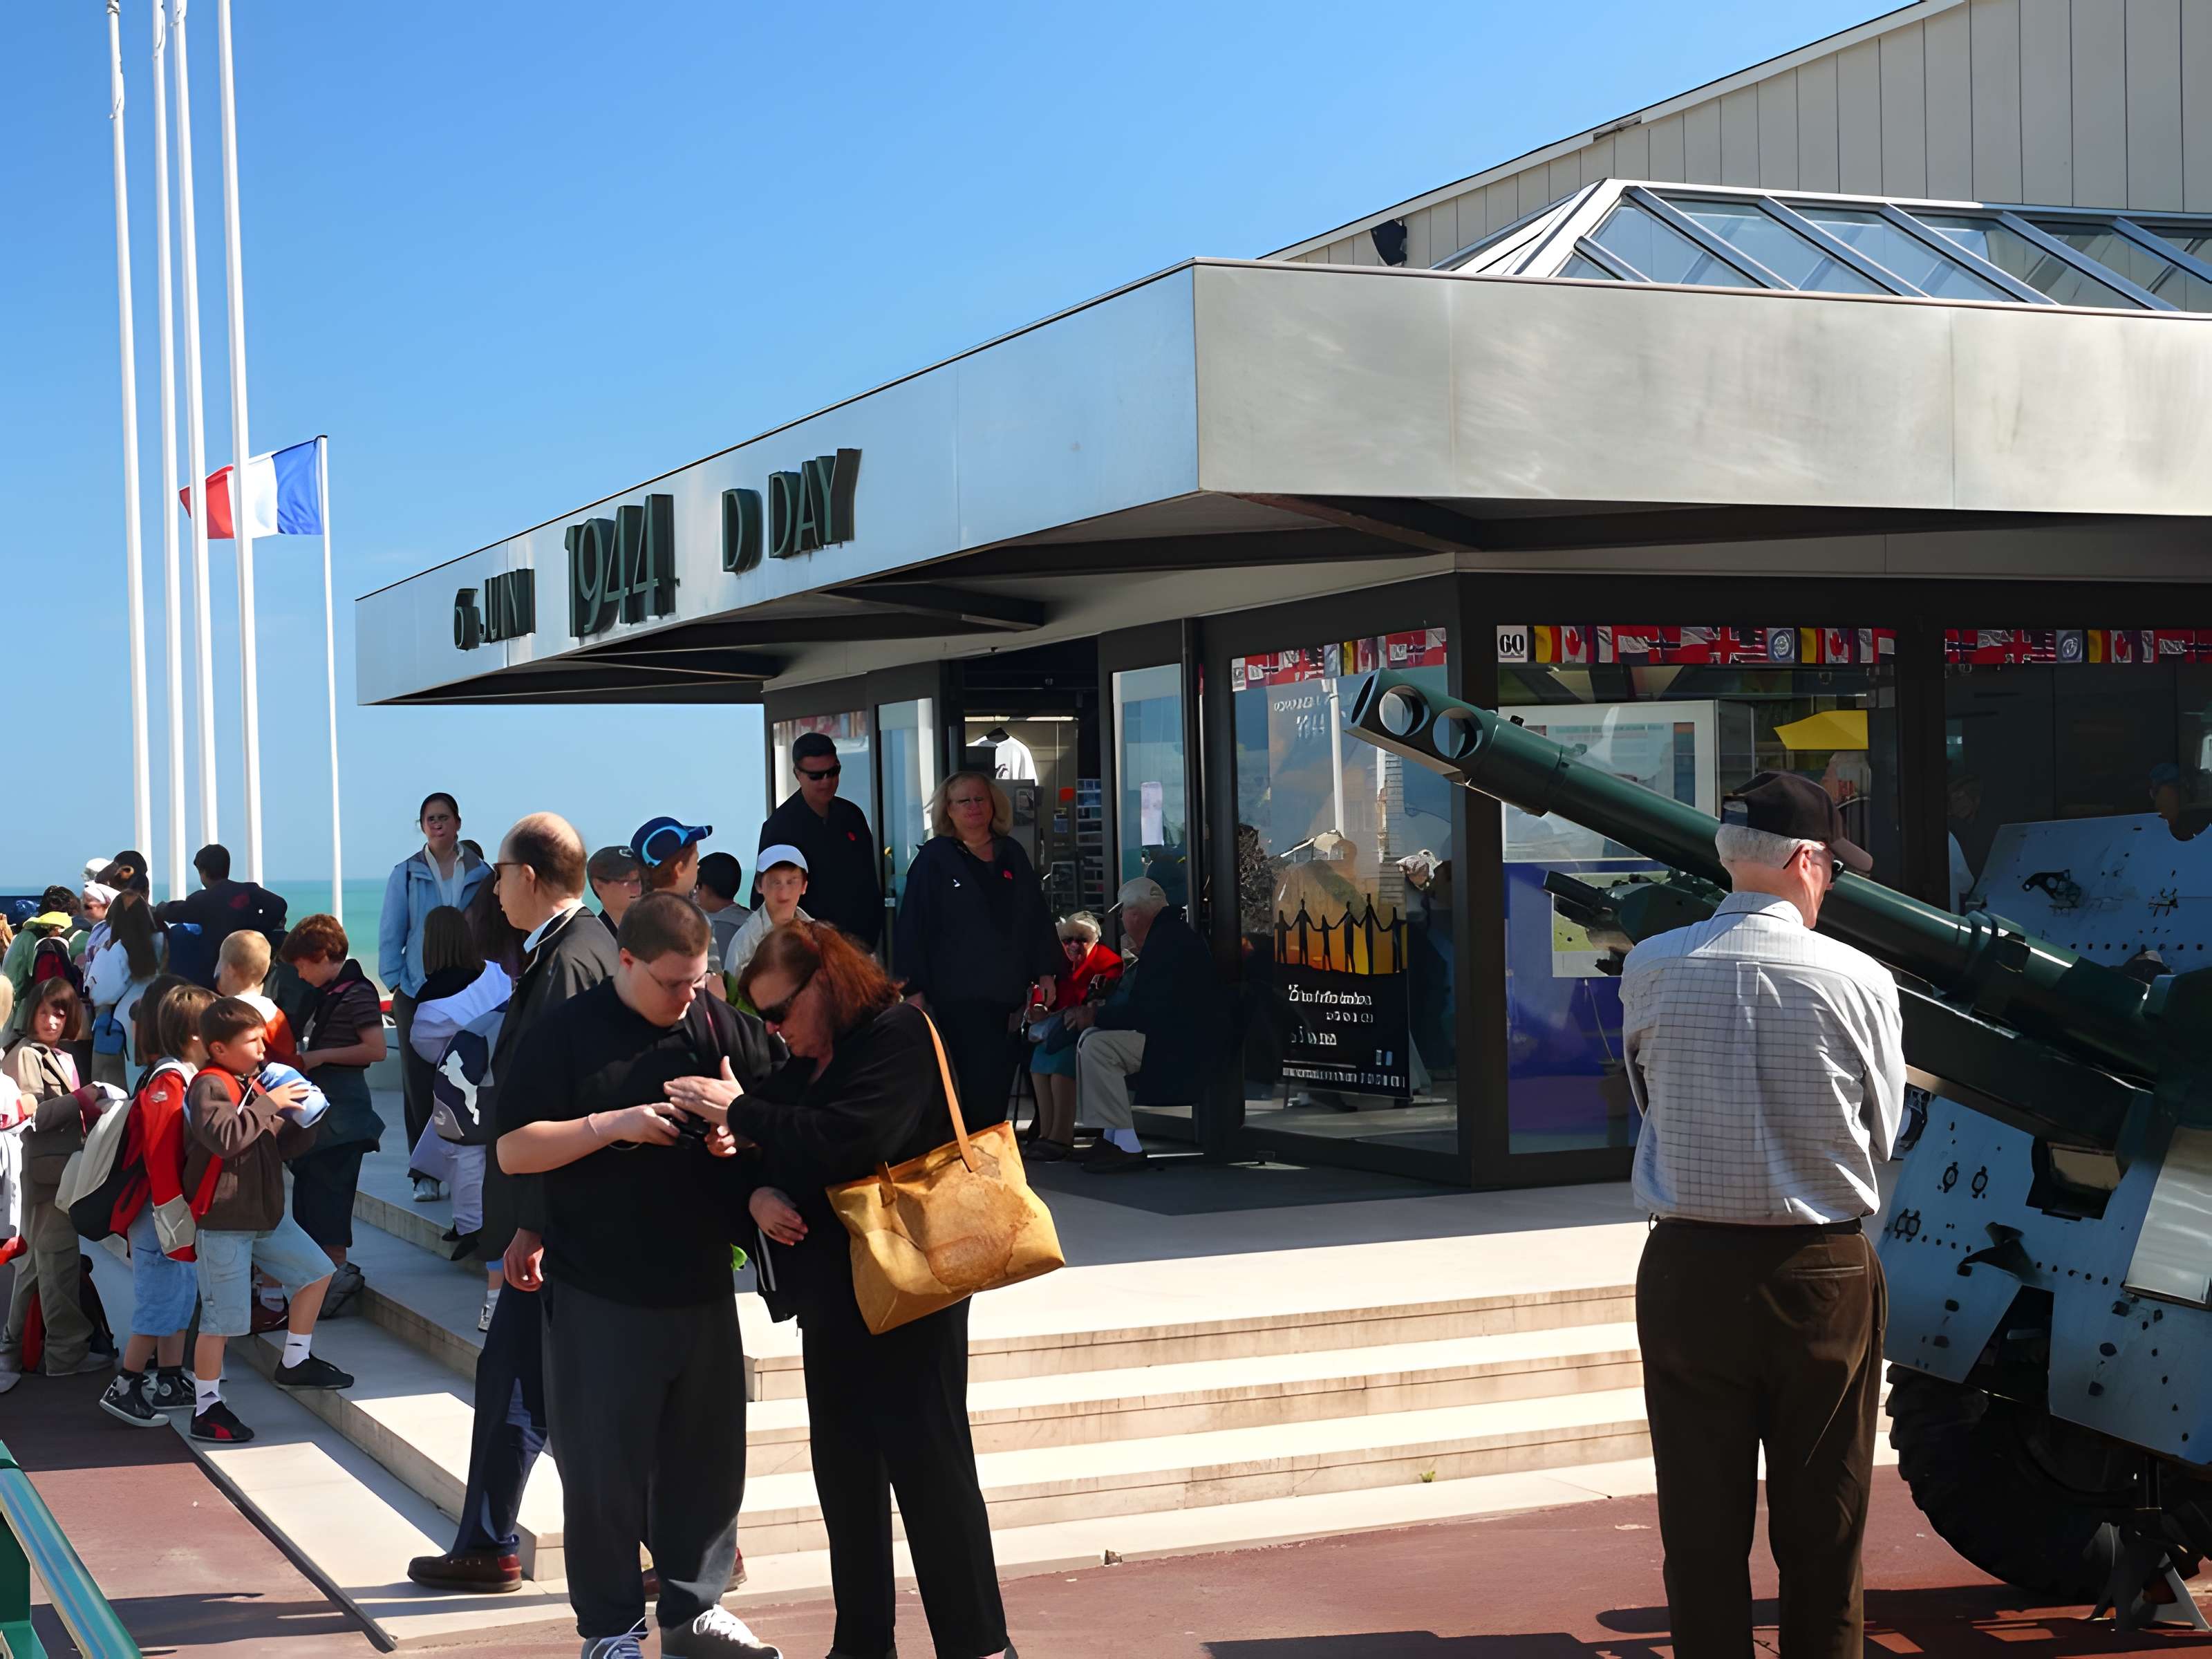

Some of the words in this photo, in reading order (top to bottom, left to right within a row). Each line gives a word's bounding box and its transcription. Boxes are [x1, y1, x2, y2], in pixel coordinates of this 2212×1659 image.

[564, 494, 675, 637] 1944
[722, 488, 763, 573] D
[769, 448, 863, 559] DAY
